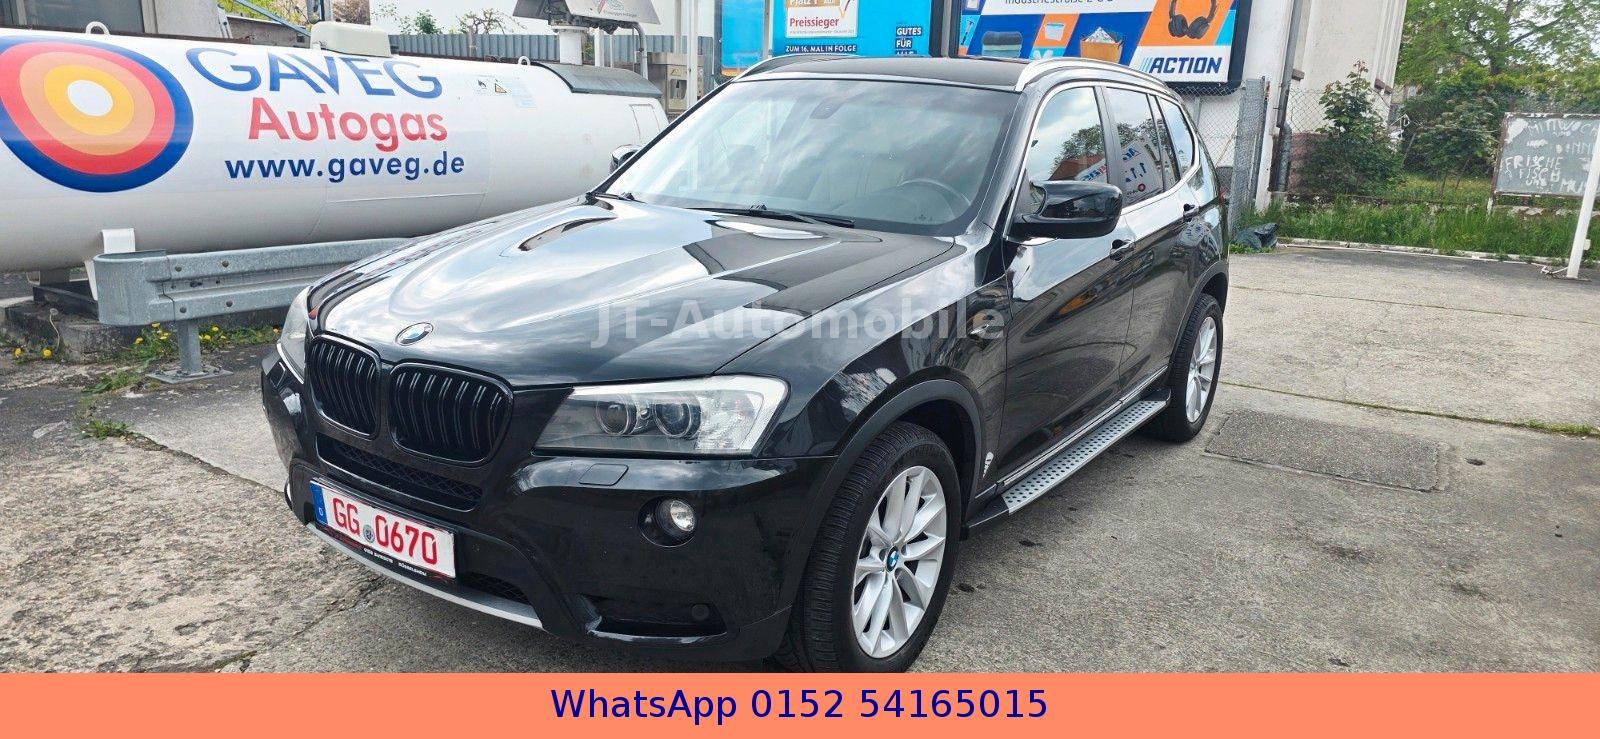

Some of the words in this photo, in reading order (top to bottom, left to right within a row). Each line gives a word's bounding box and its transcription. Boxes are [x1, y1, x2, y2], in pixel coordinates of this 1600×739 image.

[790, 16, 840, 29] Preissieger
[896, 27, 922, 36] GUTES
[785, 45, 800, 53] ZUM
[810, 45, 825, 53] MAL
[825, 45, 833, 53] IN
[834, 44, 857, 52] FOLGE
[896, 37, 912, 48] FÜR
[185, 47, 443, 99] GAVEG
[1148, 56, 1223, 75] ACTION
[248, 97, 448, 152] Autogas
[225, 151, 465, 183] www.gaveg.de
[332, 497, 361, 537] GG
[374, 514, 438, 566] 0670
